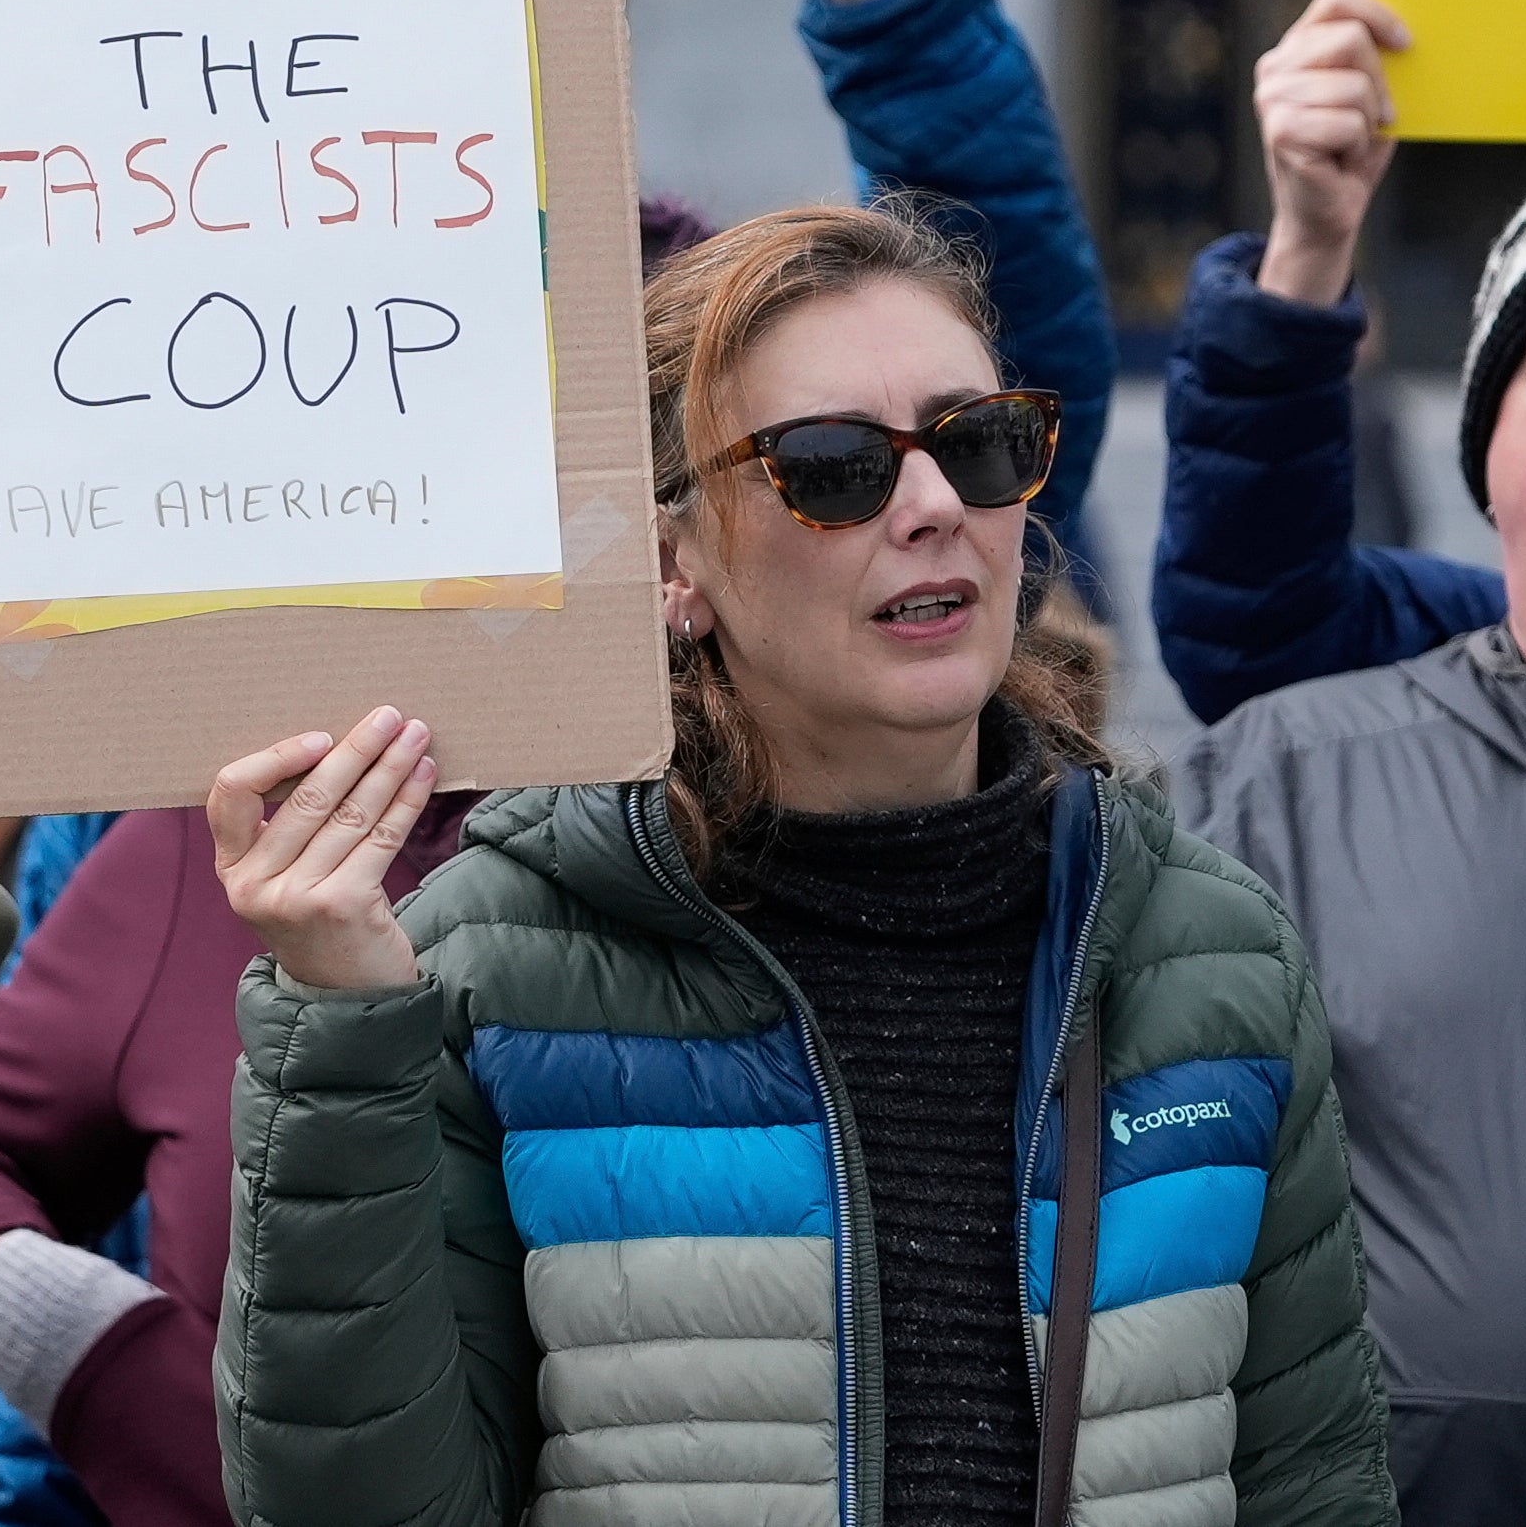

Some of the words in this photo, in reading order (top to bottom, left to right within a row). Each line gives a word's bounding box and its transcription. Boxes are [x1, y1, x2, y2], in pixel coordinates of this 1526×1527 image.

[100, 30, 360, 122] THE
[53, 292, 461, 413] COUP
[1132, 1098, 1232, 1133] cotopaxi
